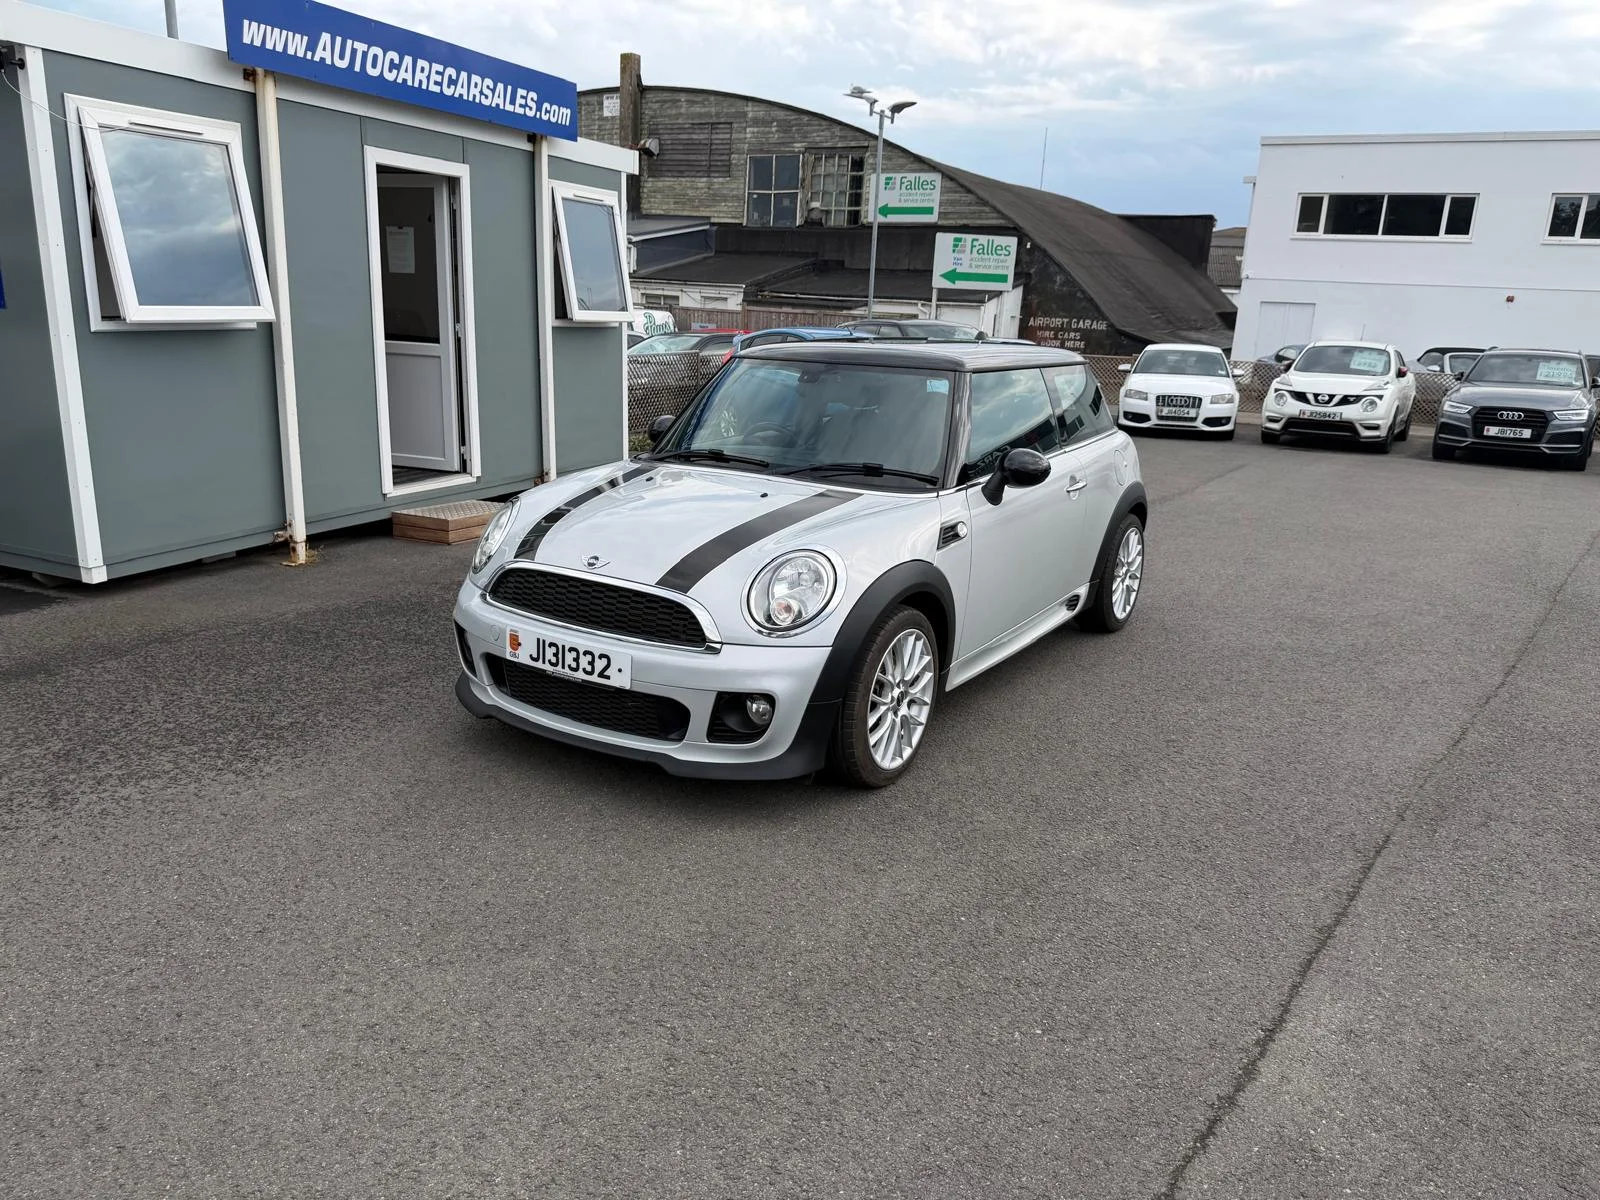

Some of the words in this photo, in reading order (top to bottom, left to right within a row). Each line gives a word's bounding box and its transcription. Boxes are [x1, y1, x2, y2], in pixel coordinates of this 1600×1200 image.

[242, 19, 571, 126] www.AUTOCARECARSALES.com
[899, 175, 937, 191] Falles
[970, 238, 1012, 257] Falles
[1028, 316, 1069, 328] AIRPORT
[1071, 318, 1109, 330] GARAGE
[1058, 331, 1081, 340] CARS
[1064, 341, 1086, 349] HERE
[1495, 427, 1524, 437] J81765
[509, 651, 520, 660] GBJ
[529, 637, 612, 680] J131332
